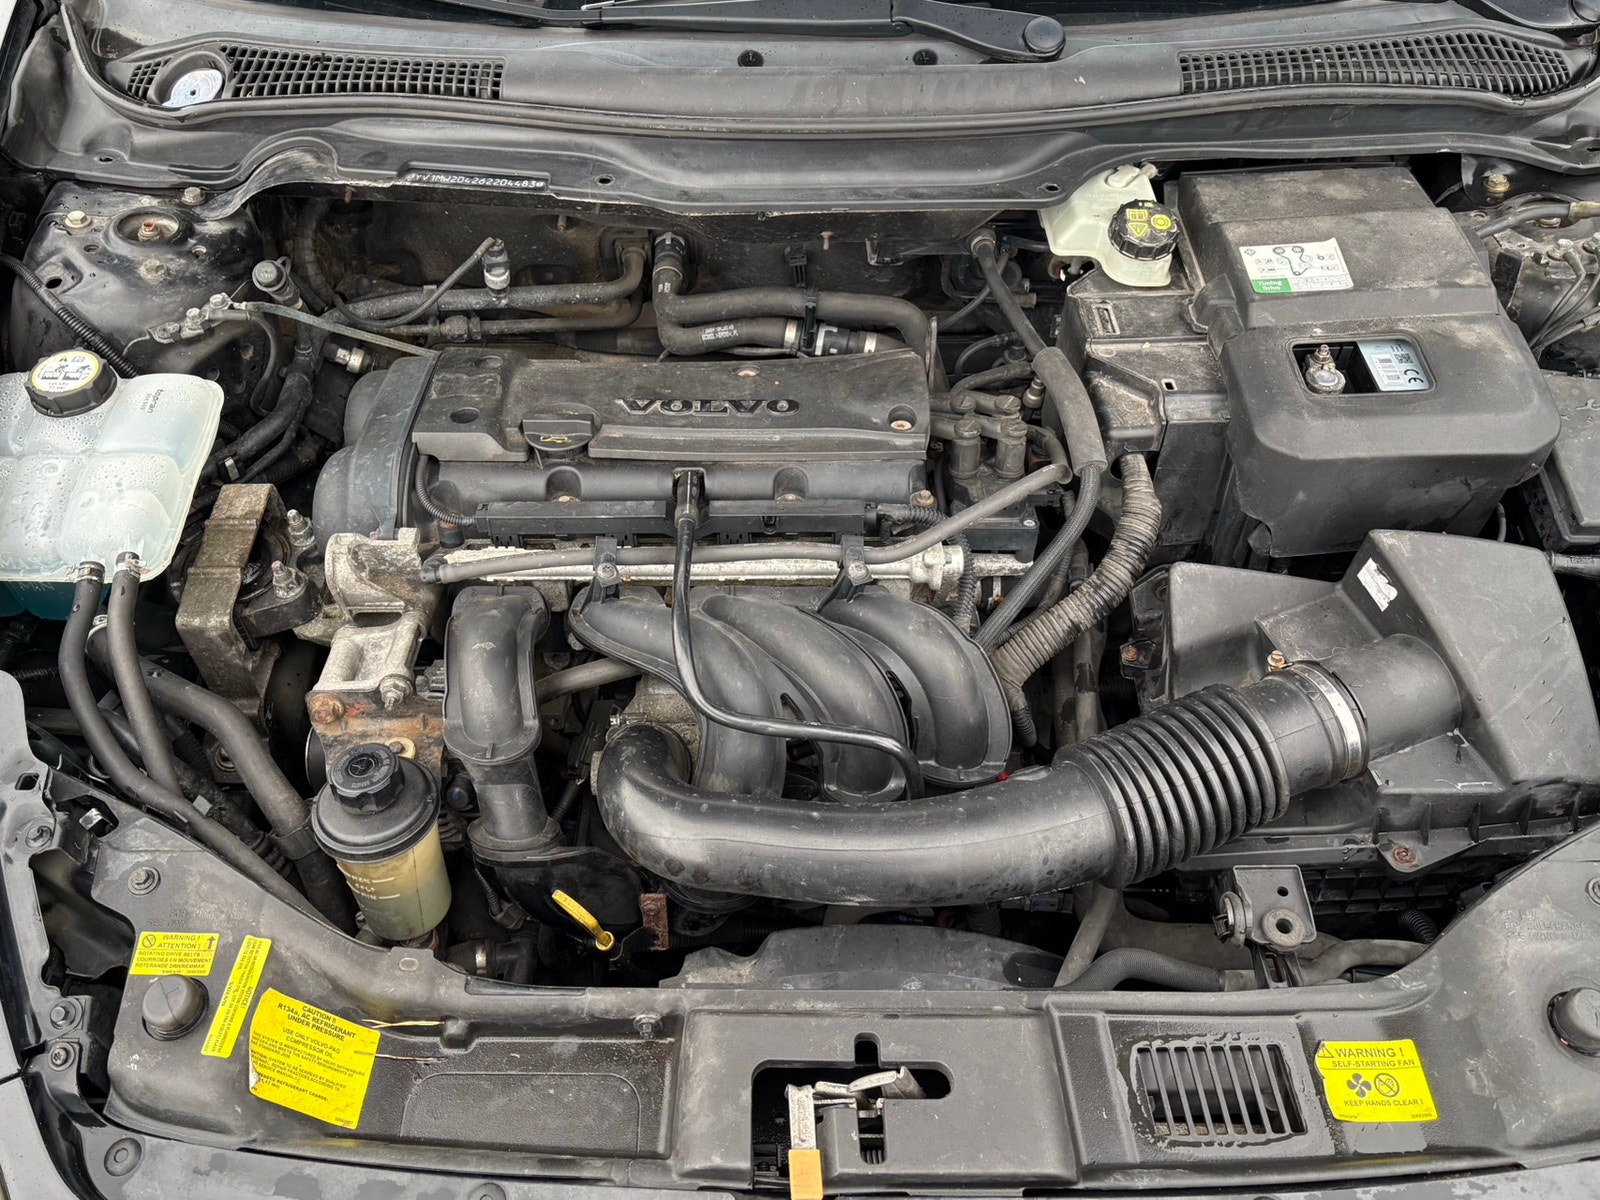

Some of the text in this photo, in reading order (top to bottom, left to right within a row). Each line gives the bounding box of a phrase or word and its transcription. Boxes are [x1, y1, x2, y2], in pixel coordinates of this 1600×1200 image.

[147, 388, 164, 414] topran
[615, 399, 800, 417] VOLVO
[220, 981, 234, 1006] VOLVO
[277, 1002, 355, 1038] R134a, AC REFRIGERANT
[302, 1005, 331, 1021] CAUTION
[287, 1013, 345, 1041] UNDER PRESSURE
[282, 1026, 340, 1054] USE ONLY VOLVO-PAG
[285, 1035, 324, 1054] COMPRESSOR
[283, 1043, 316, 1058] MANUFACTURED
[1334, 1047, 1404, 1058] WARNING !
[301, 1054, 316, 1063] SAFETY
[316, 1060, 347, 1075] REQUIREMENTS
[1331, 1058, 1415, 1068] SELF-STARTING FAN
[276, 1079, 308, 1094] REFRIGERANT
